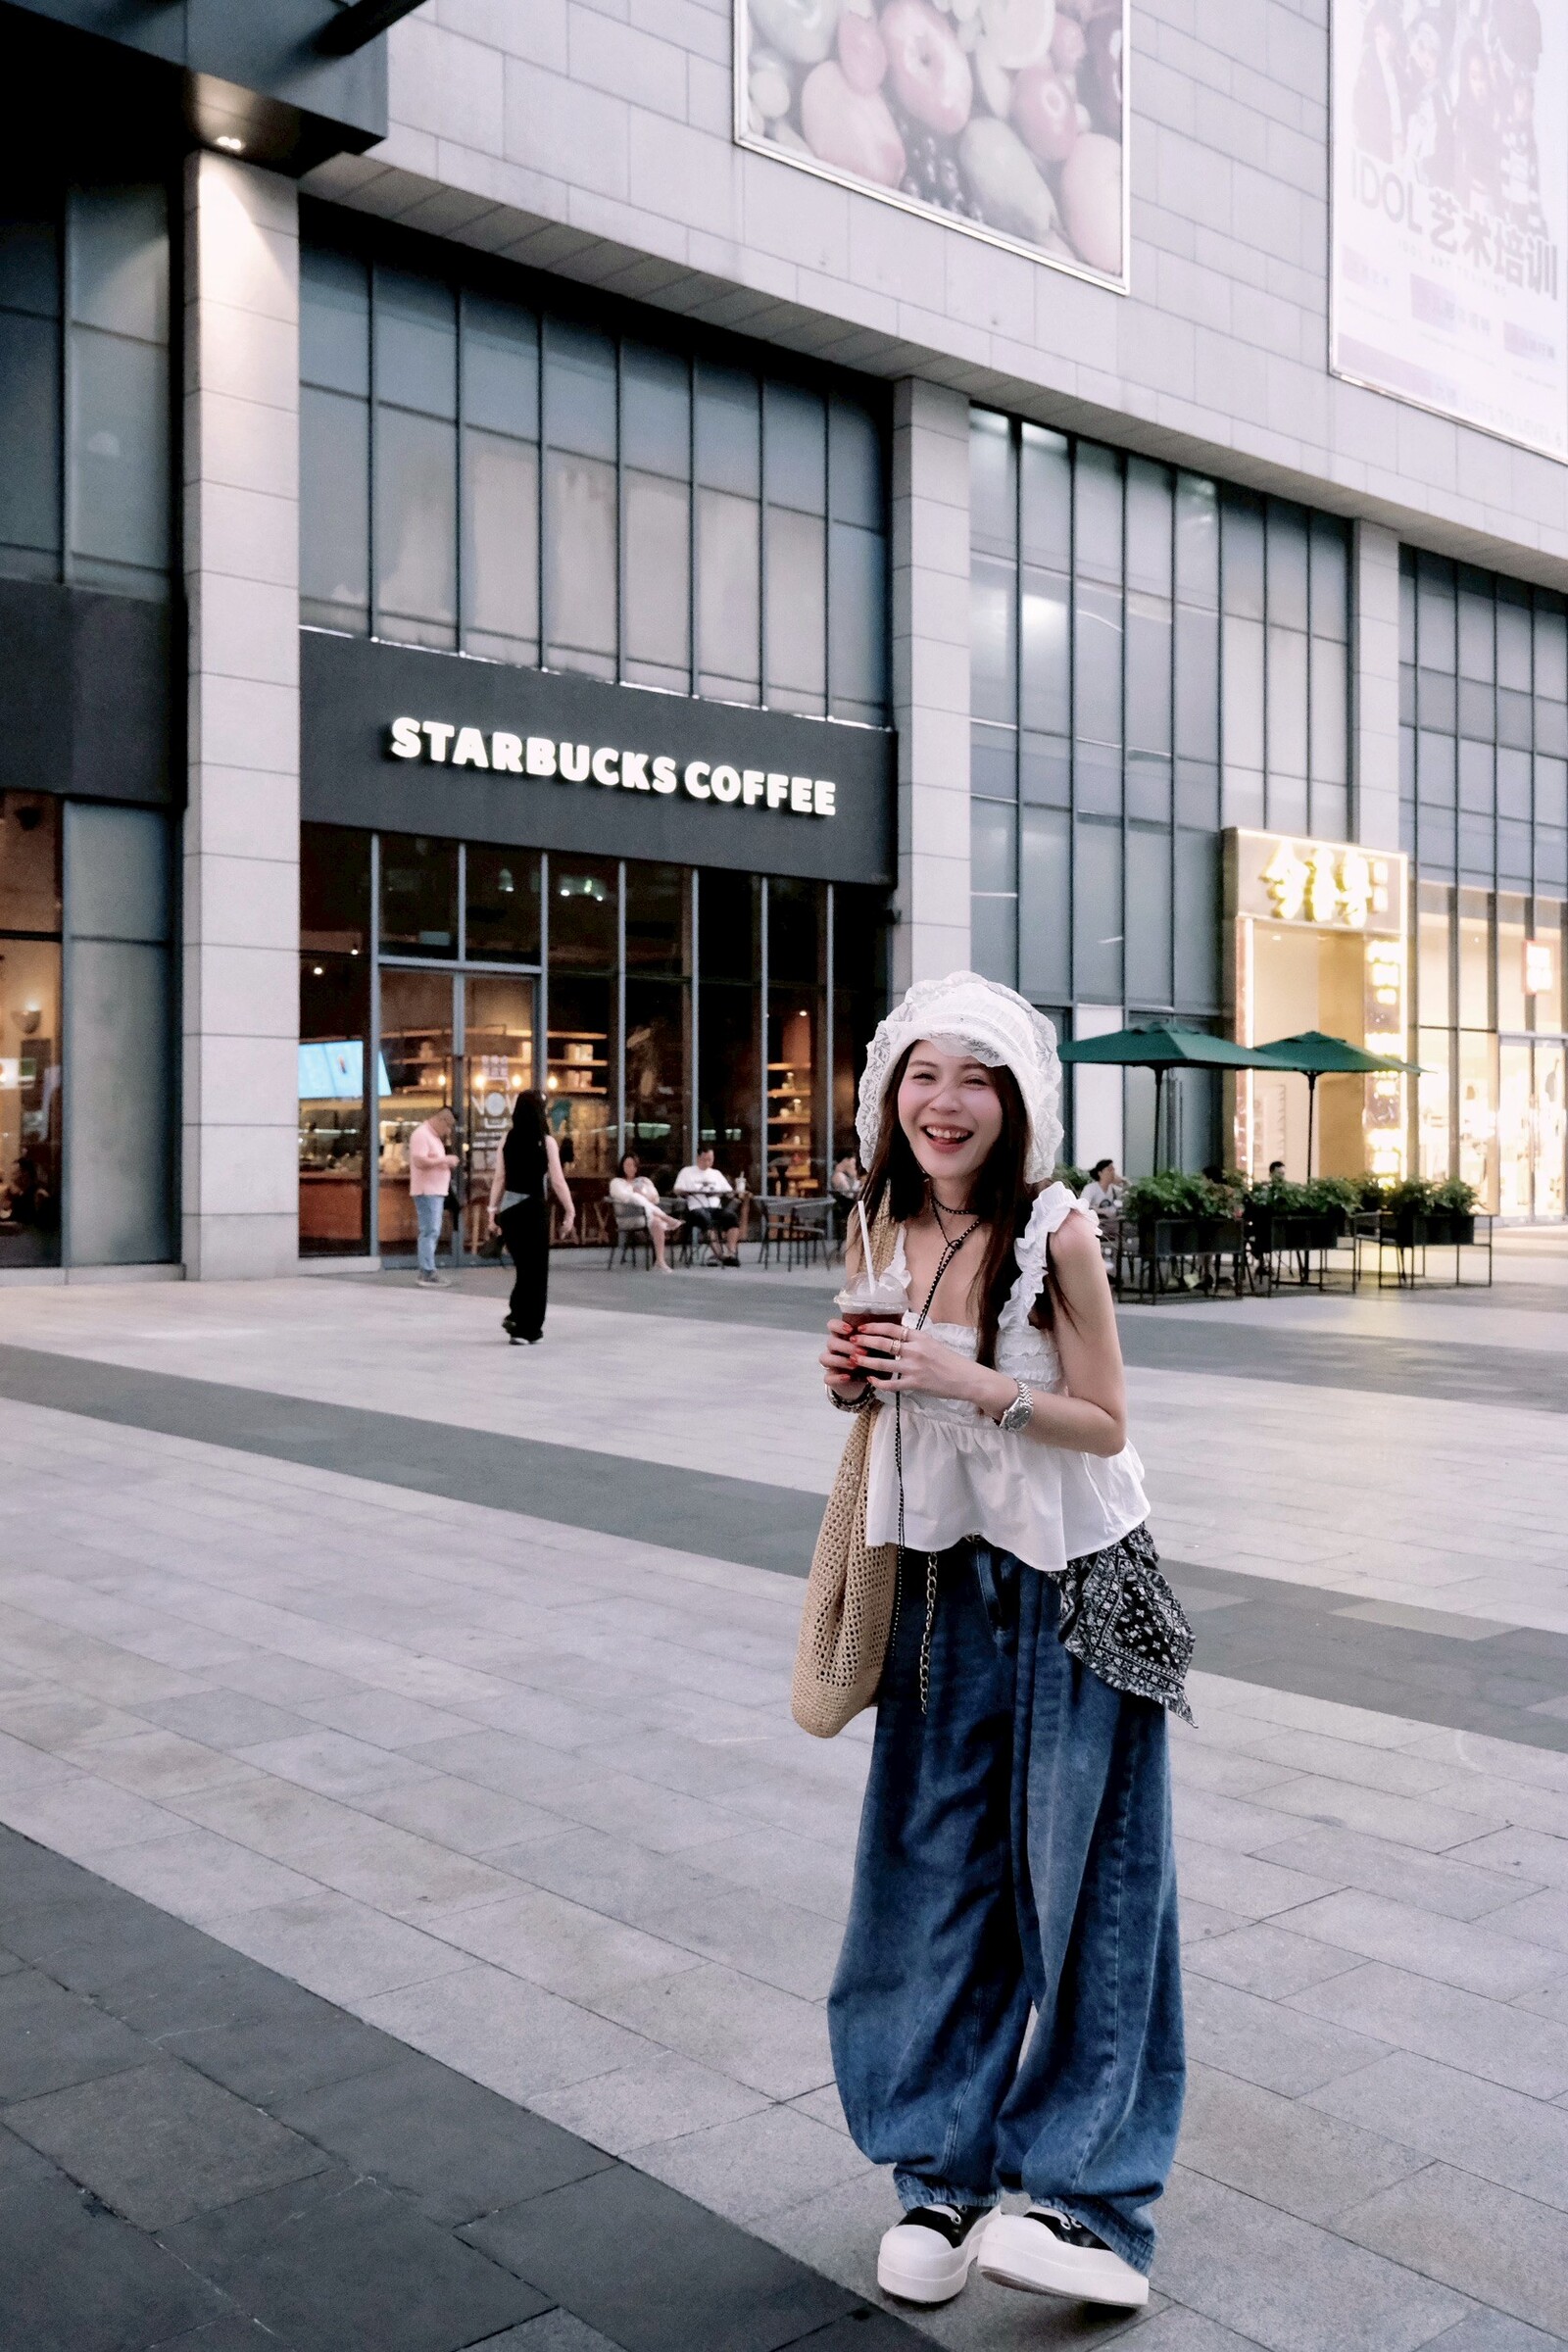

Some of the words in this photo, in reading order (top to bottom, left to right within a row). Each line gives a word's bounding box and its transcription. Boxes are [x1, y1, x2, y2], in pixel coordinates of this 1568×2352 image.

[1349, 147, 1423, 235] IDOL
[1428, 189, 1559, 301] 艺术培训
[390, 716, 677, 795] STARBUCKS
[685, 760, 837, 816] COFFEE
